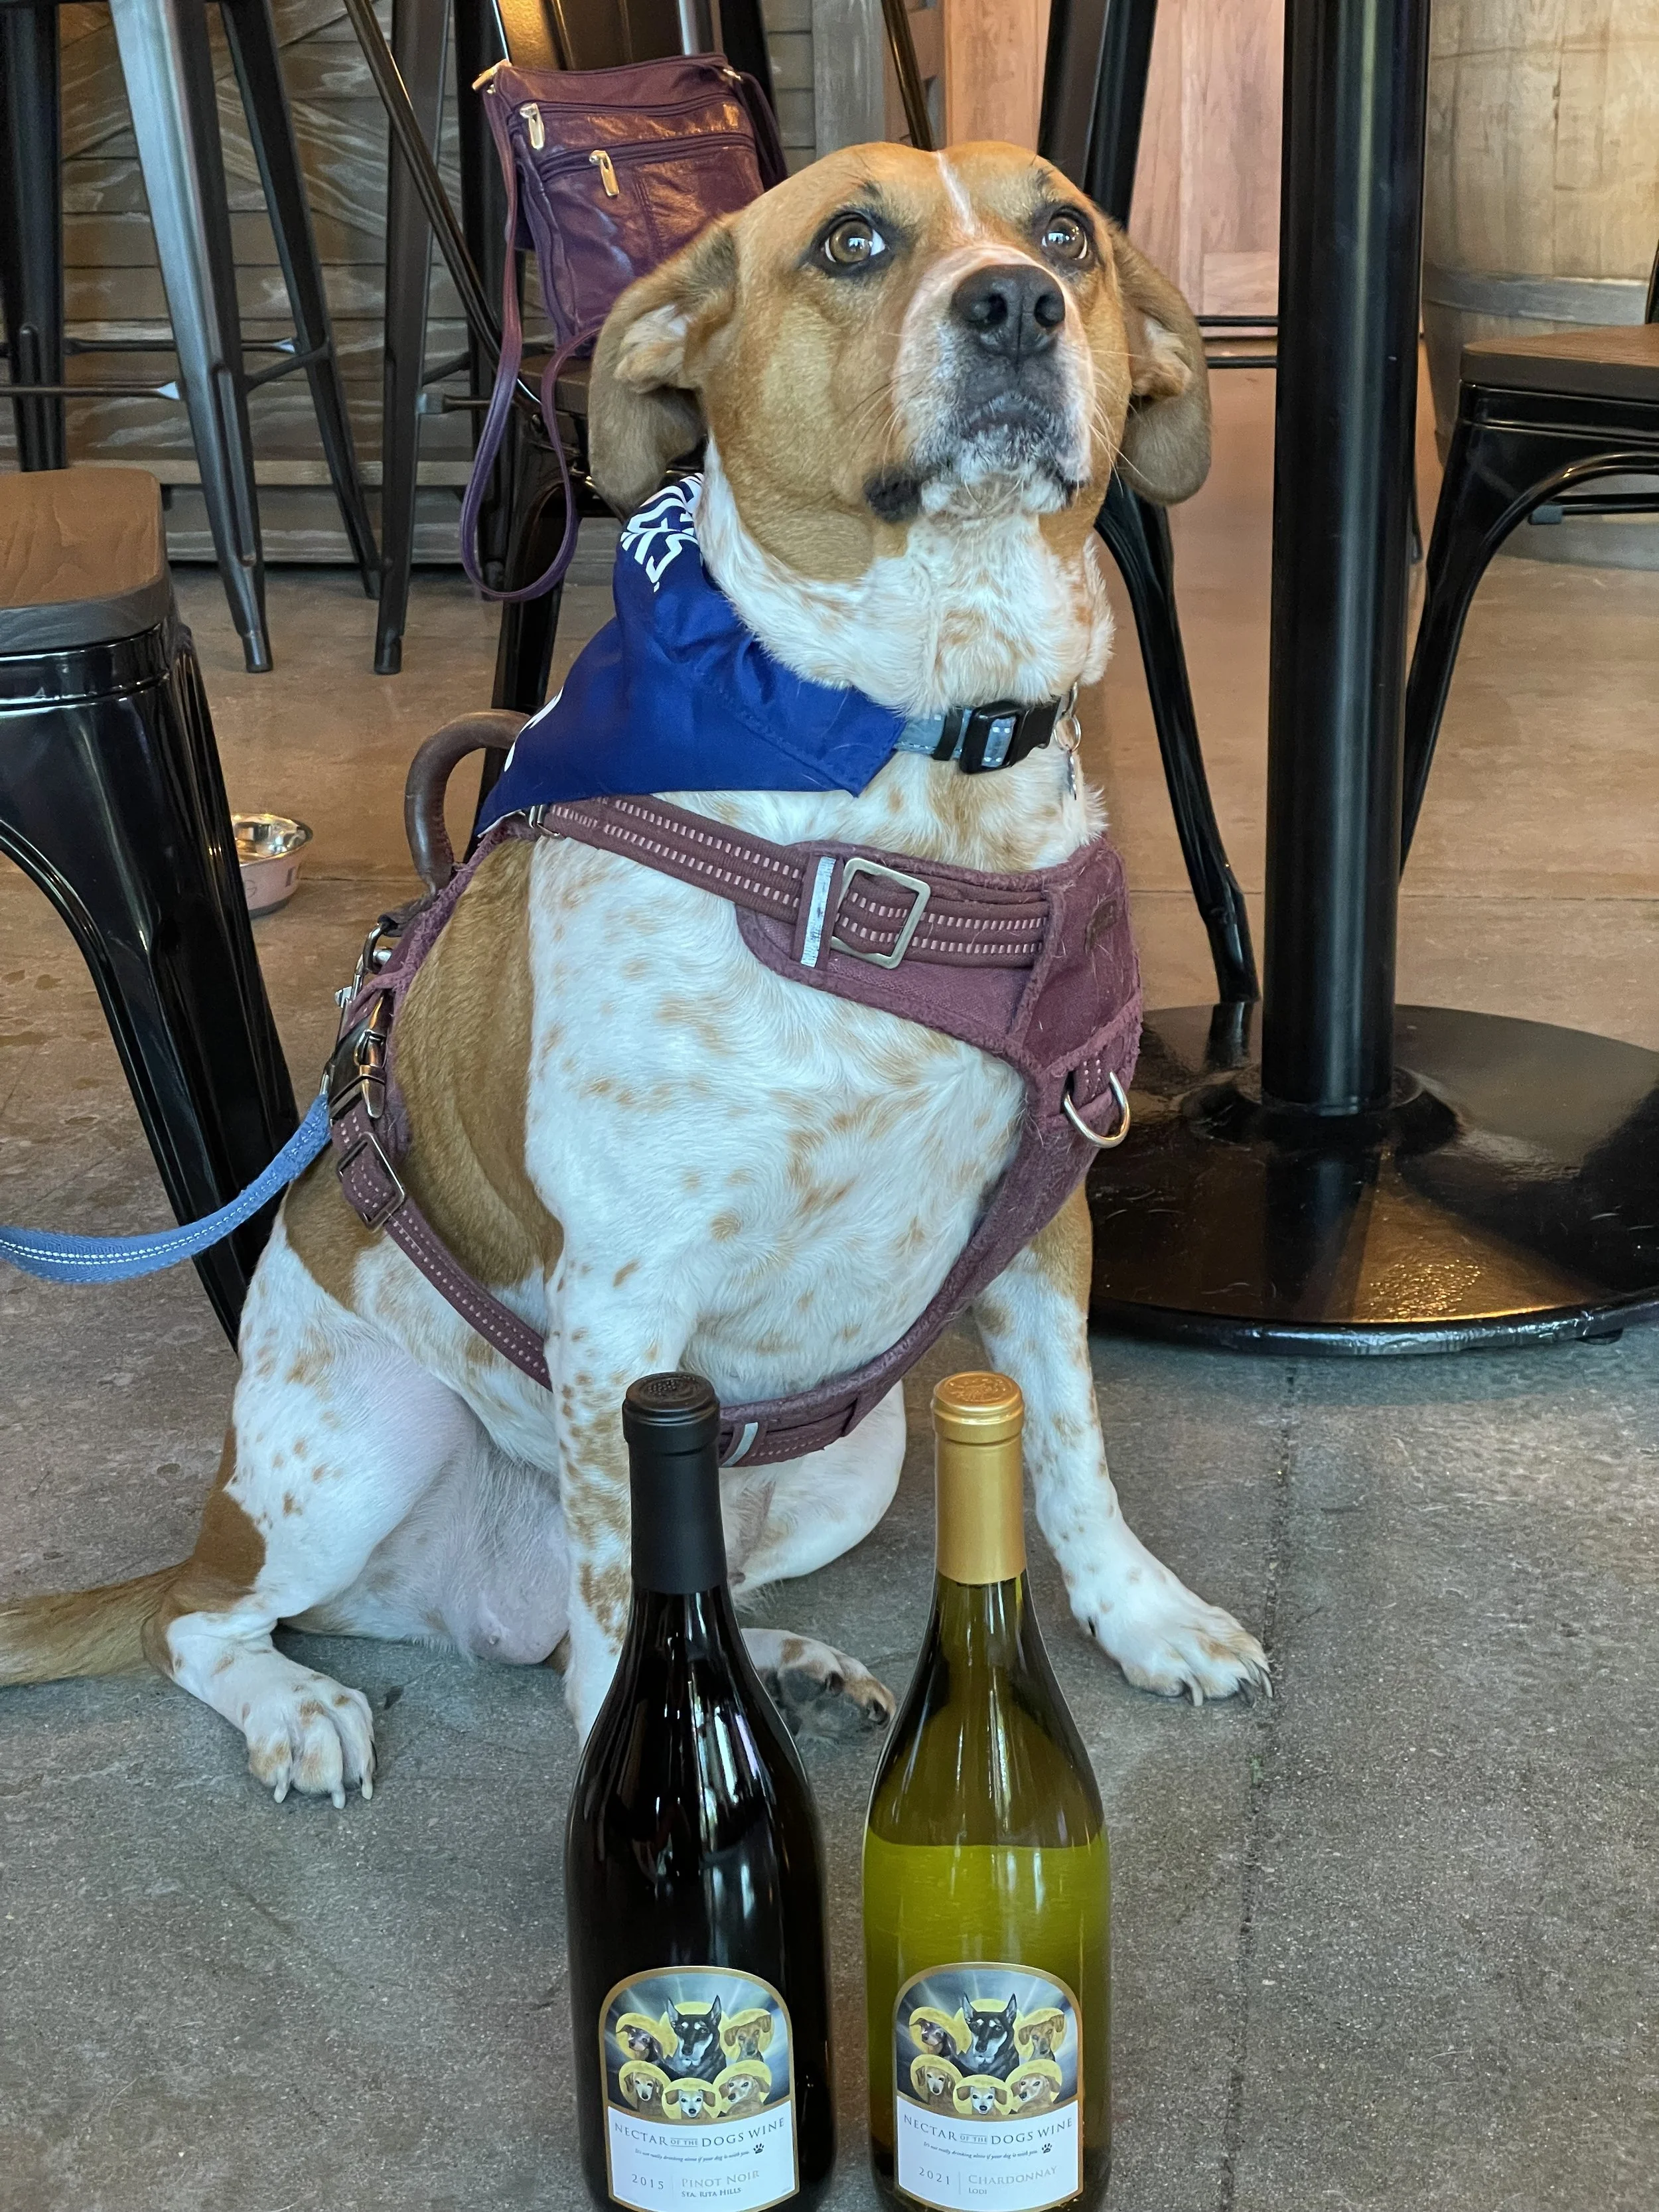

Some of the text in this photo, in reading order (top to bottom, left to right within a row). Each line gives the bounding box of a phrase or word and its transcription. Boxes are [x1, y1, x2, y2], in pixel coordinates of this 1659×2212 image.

[614, 2122, 668, 2146] NECTAR
[702, 2132, 744, 2148] DOGS
[749, 2117, 785, 2138] WINE
[903, 2114, 957, 2141] NECTAR
[991, 2131, 1033, 2145] DOGS
[1037, 2117, 1073, 2138] WINE
[632, 2174, 664, 2190] 2015
[682, 2170, 760, 2188] PINOT NOIR
[918, 2166, 950, 2185] 2021
[968, 2166, 1058, 2185] CHARDONNAY
[719, 2187, 742, 2196] HILLS
